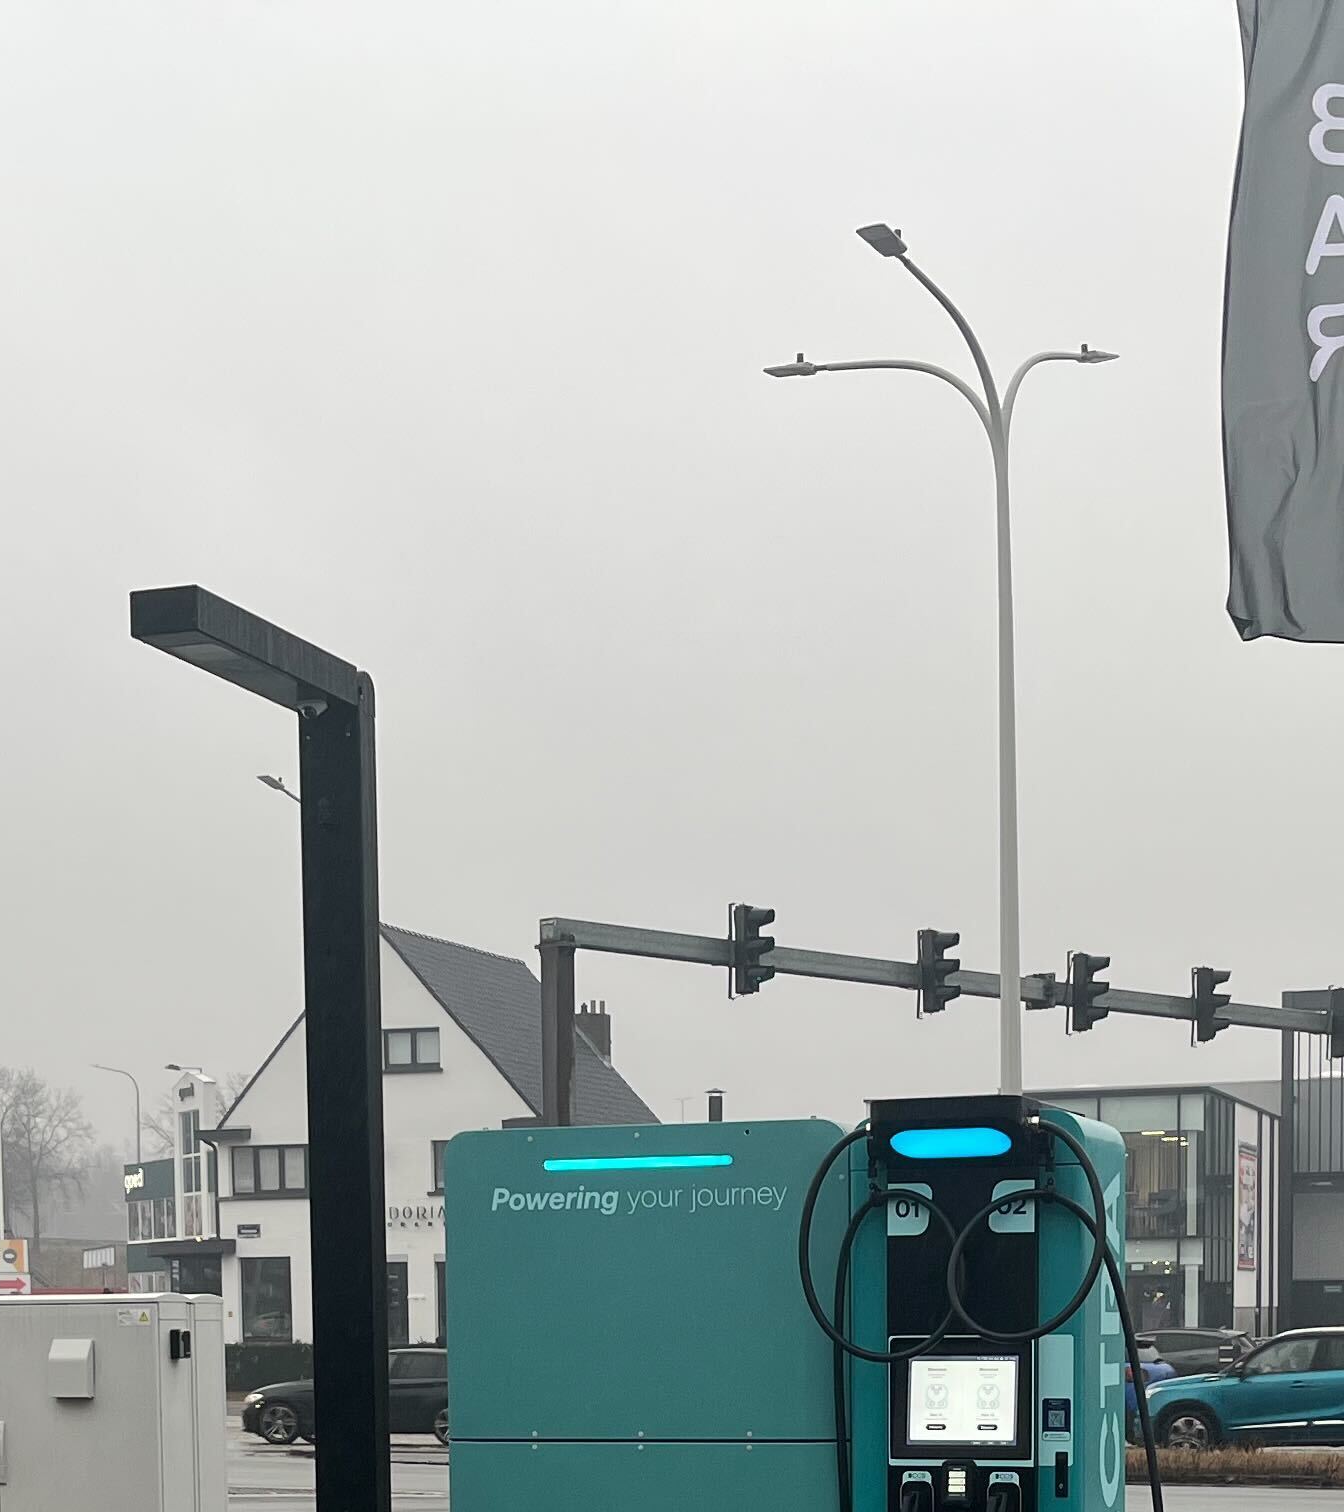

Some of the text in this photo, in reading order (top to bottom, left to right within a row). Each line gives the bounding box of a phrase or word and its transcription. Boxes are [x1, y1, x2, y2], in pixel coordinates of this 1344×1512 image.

[491, 1183, 788, 1215] Powering your journey
[894, 1198, 922, 1218] 01
[996, 1197, 1027, 1215] 02
